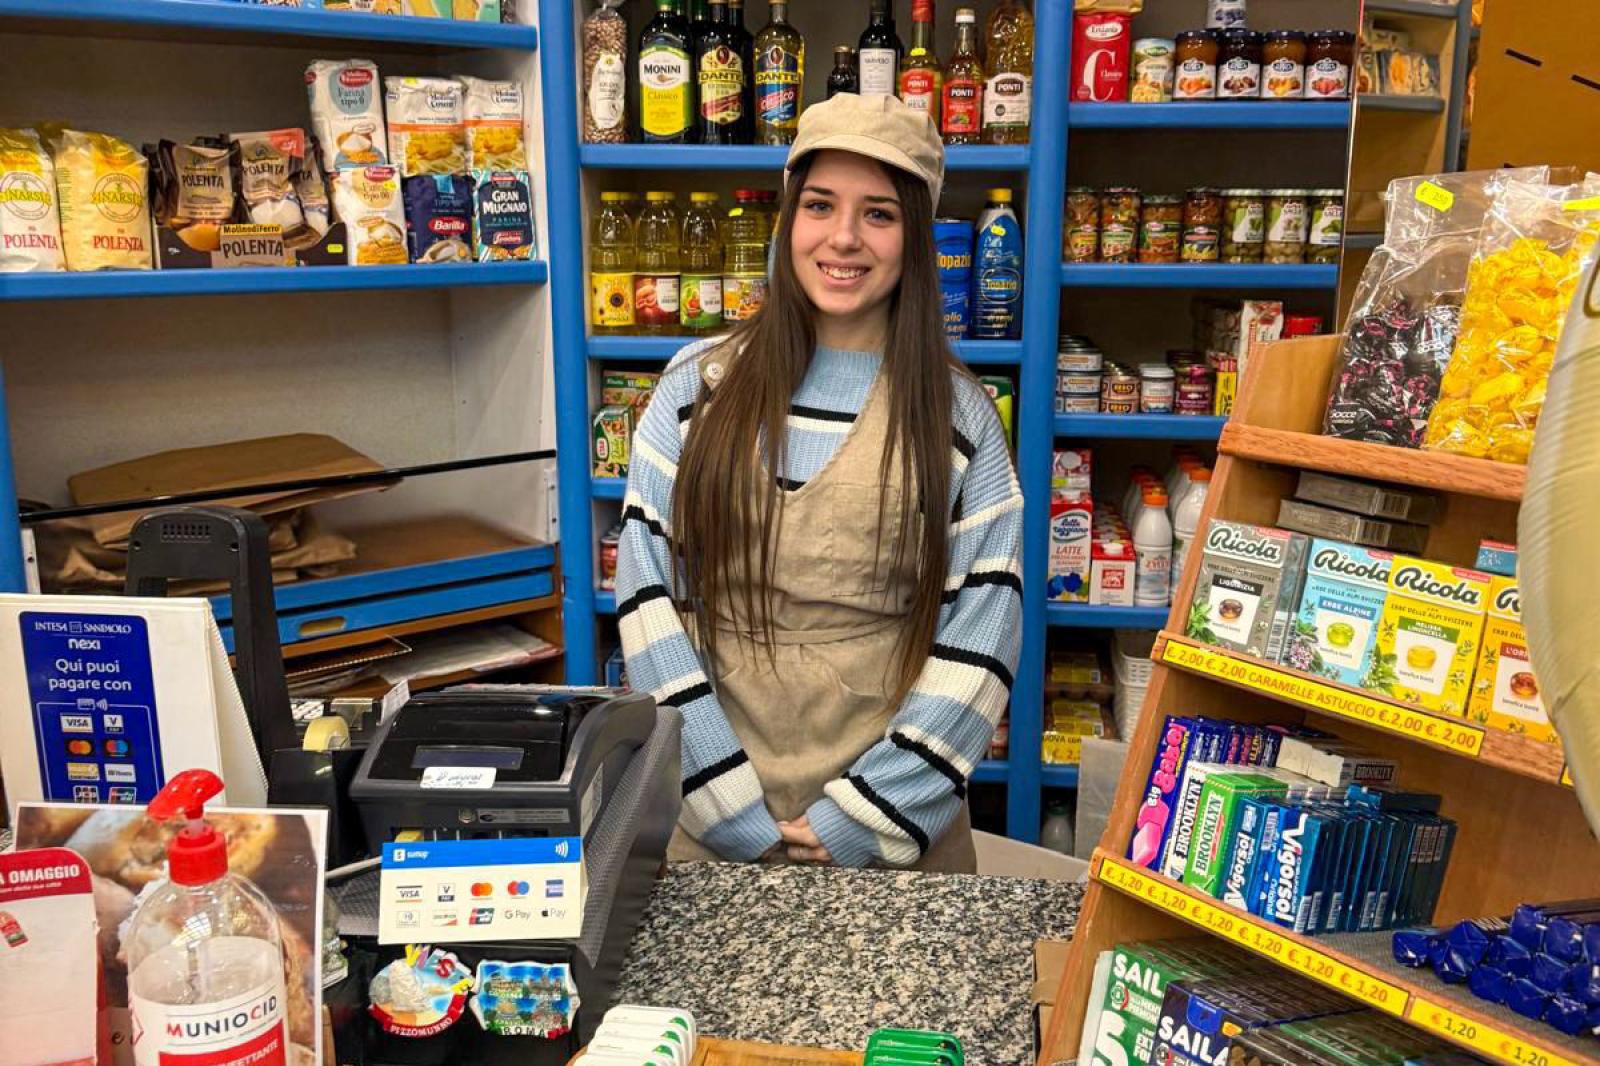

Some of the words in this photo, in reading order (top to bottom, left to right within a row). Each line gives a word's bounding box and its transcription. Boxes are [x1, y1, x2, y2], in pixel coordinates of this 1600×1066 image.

[643, 64, 681, 74] MONINI
[700, 71, 740, 80] DANTE
[756, 73, 798, 82] DANTE
[951, 88, 974, 97] PONTI
[998, 83, 1021, 91] PONTI
[243, 162, 285, 176] POLENTA
[181, 174, 224, 189] POLENTA
[491, 190, 520, 202] GRAN
[483, 201, 528, 215] MUGNAIO
[433, 220, 465, 231] Barilla
[4, 234, 58, 249] POLENTA
[93, 235, 144, 251] POLENTA
[222, 239, 284, 258] POLENTA
[1210, 527, 1279, 559] Ricola
[1314, 549, 1391, 583] Ricola
[1395, 567, 1479, 605] Ricola
[1322, 599, 1342, 610] ERBE
[1343, 603, 1372, 617] ALPINE
[35, 621, 68, 632] INTESA
[1493, 628, 1509, 637] ERBE
[68, 638, 101, 650] nexi
[55, 658, 83, 674] Qui
[86, 659, 120, 675] puoi
[48, 678, 101, 692] pagare
[104, 680, 132, 691] con
[1179, 650, 1204, 665] 2,00
[1219, 662, 1247, 679] 2,00
[1249, 671, 1315, 700] CARAMELLE
[1316, 692, 1375, 717] ASTUCCIO
[1443, 728, 1477, 749] 2,00
[66, 718, 89, 727] VISA
[1176, 778, 1202, 857] BROOKLYN
[1195, 794, 1223, 873] BROOKLYN
[8, 864, 80, 884] OMAGGIO
[1224, 832, 1250, 911] Vigorsol
[1275, 813, 1308, 922] Vigorsol
[399, 890, 420, 899] VISA
[515, 910, 532, 920] Pay
[550, 908, 567, 919] Pay
[1118, 872, 1144, 890] 1,20
[1161, 891, 1187, 911] 1,20
[1206, 912, 1233, 932] 1,20
[1252, 932, 1283, 955] 1,20
[1303, 955, 1335, 978] 1,20
[1356, 979, 1389, 1003] 1,20
[1113, 954, 1165, 999] SAIL
[166, 995, 278, 1038] MUNIOCID
[1158, 1015, 1230, 1066] SAILA
[1443, 1018, 1477, 1040] 1,20
[1514, 1046, 1549, 1066] 1,20
